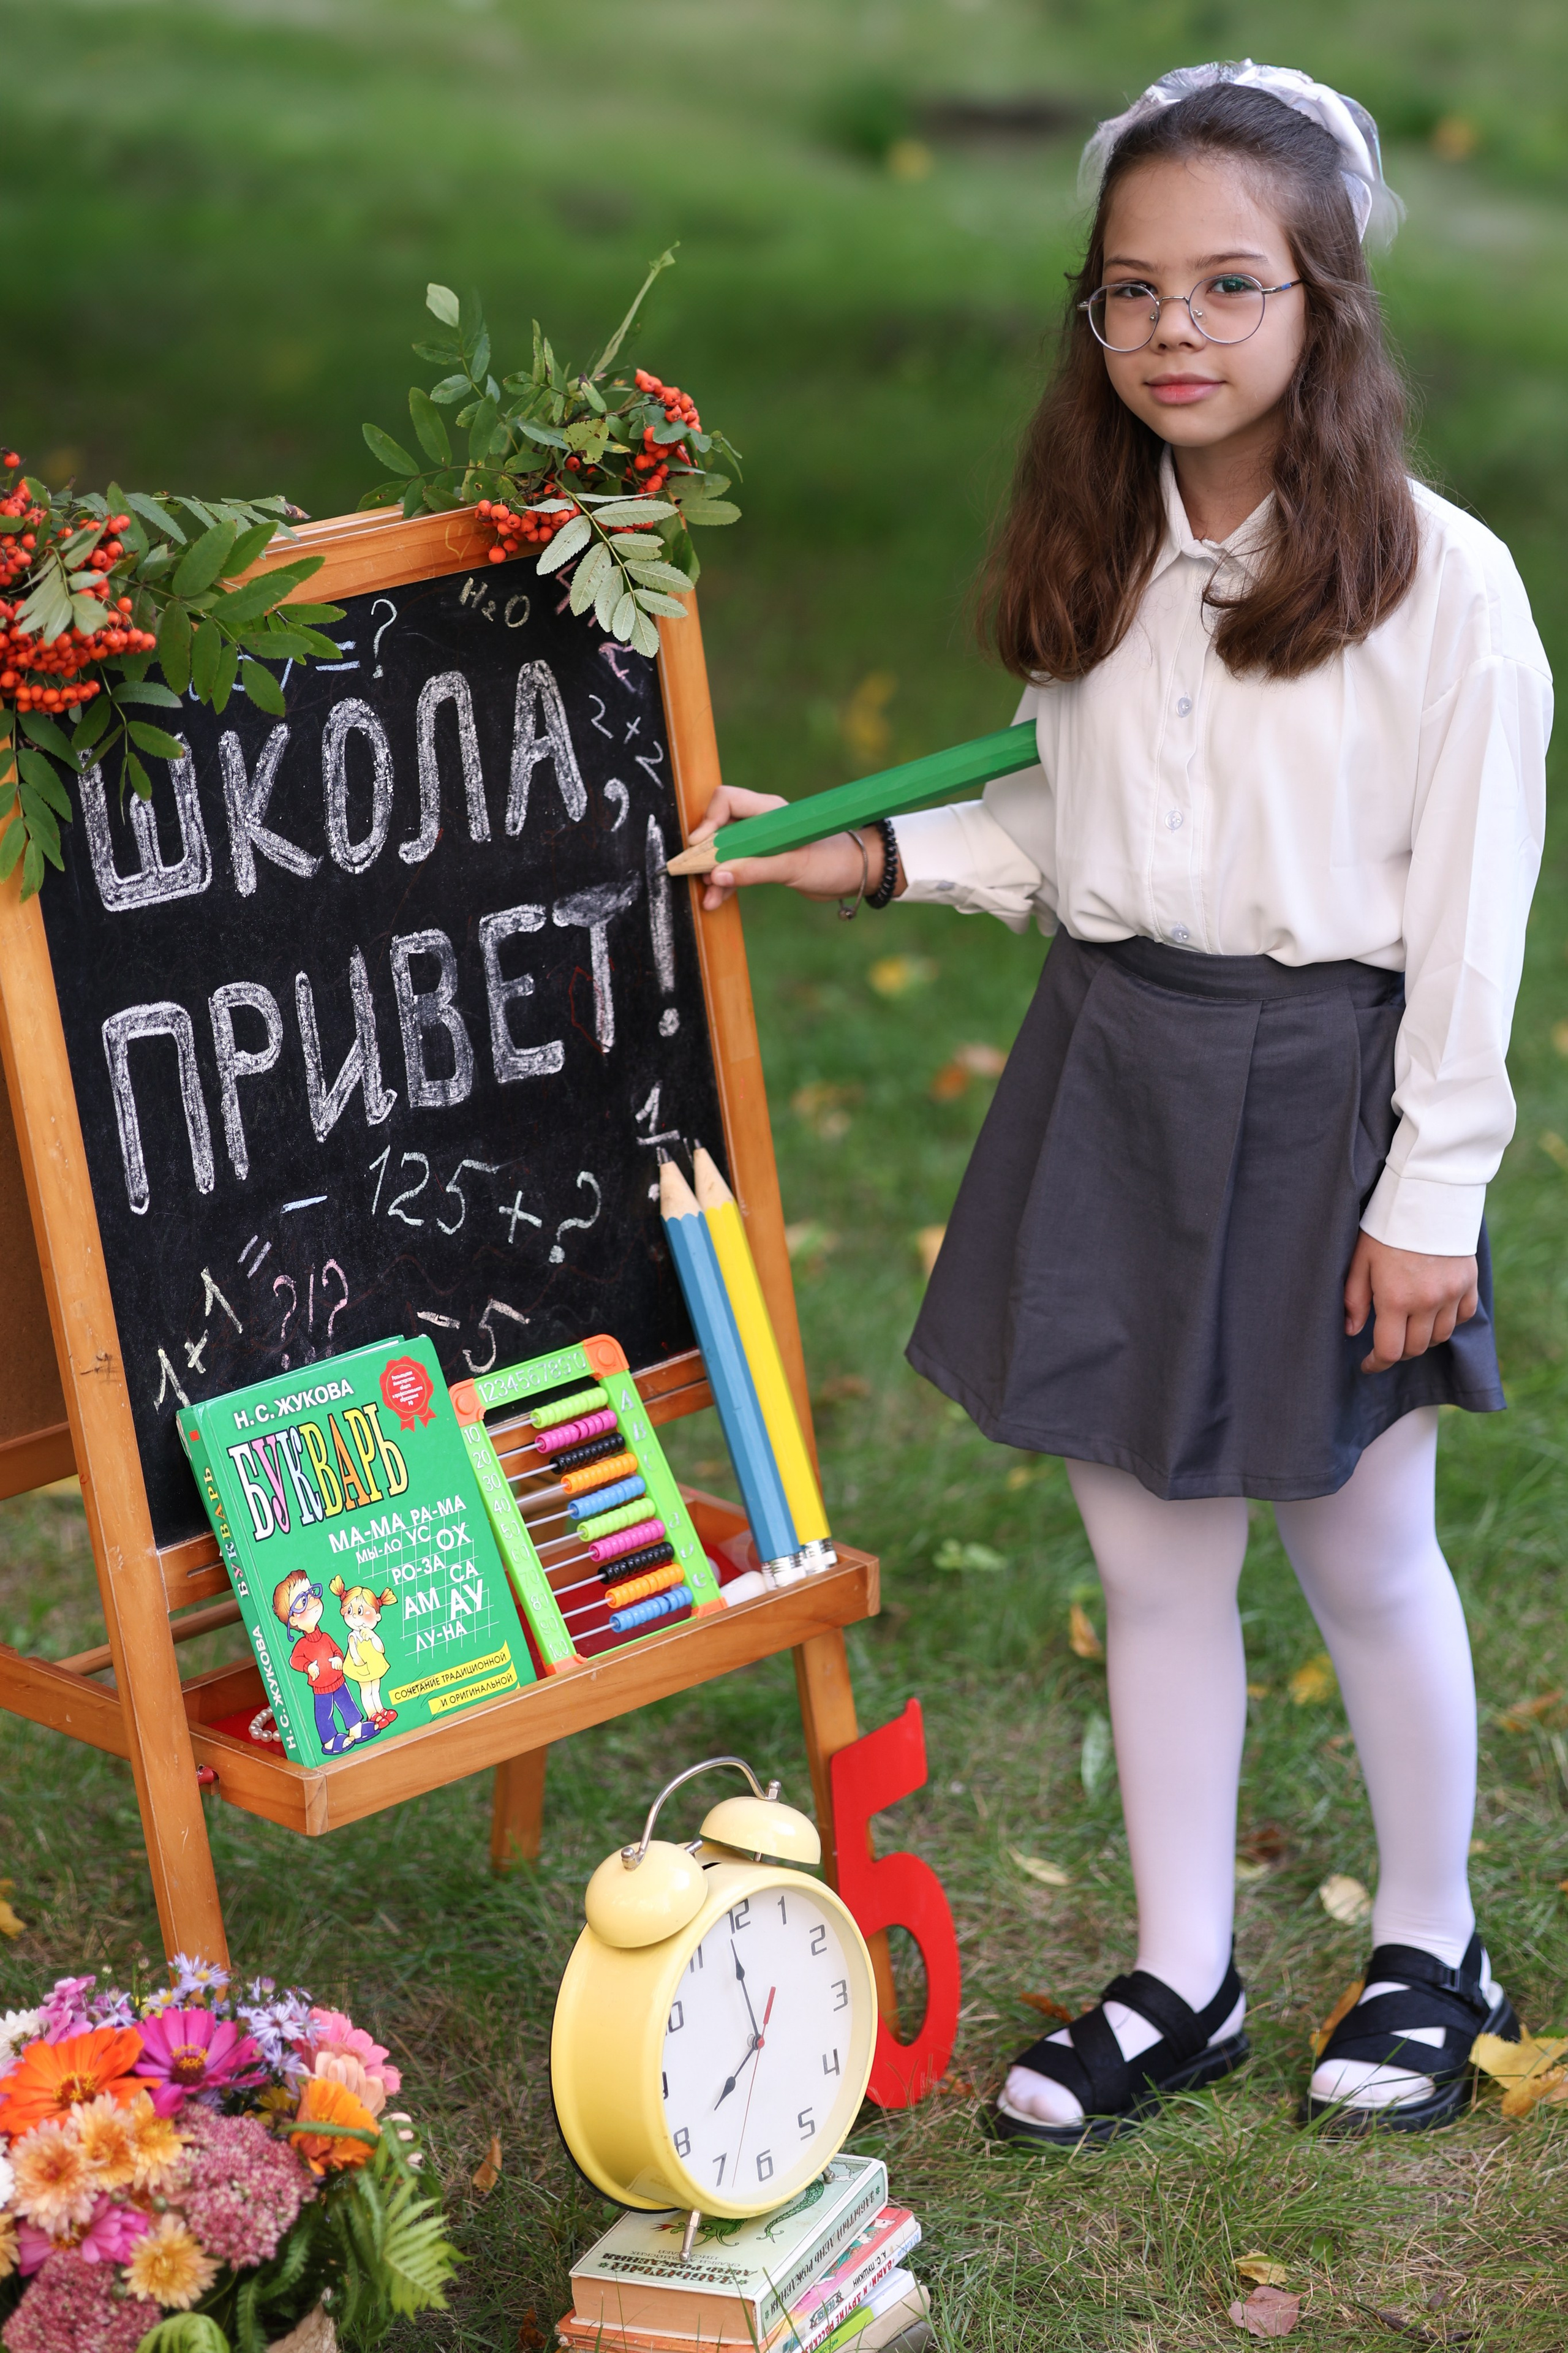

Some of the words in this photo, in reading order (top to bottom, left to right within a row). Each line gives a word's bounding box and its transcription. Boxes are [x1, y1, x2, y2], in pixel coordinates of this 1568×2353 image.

[100, 814, 680, 1216] ПРИВЕТ!
[233, 1410, 254, 1430] Н.
[255, 1404, 275, 1423] С.
[274, 1378, 354, 1418] ЖУКОВА
[464, 1426, 481, 1445] 10
[226, 1402, 409, 1543] БУКВАРЬ
[472, 1449, 492, 1469] 20
[482, 1473, 502, 1492] 30
[493, 1495, 511, 1514] 40
[203, 1467, 250, 1598] БУКВАРЬ
[328, 1512, 407, 1554] МА-МА
[409, 1494, 467, 1527] РА-МА
[500, 1520, 521, 1539] 50
[355, 1538, 402, 1565] МЫ-ЛО
[405, 1525, 432, 1546] УС
[435, 1522, 472, 1551] ОХ
[391, 1554, 447, 1585] РО-ЗА
[449, 1560, 480, 1583] СА
[404, 1587, 441, 1620] АМ
[450, 1578, 483, 1621] АУ
[416, 1620, 468, 1652] ЛУ-НА
[252, 1625, 284, 1708] ЖУКОВА
[394, 1677, 440, 1701] СОЧЕТАНИЕ
[441, 1652, 507, 1683] ТРАДИЦИОННОЙ
[440, 1698, 448, 1707] И
[449, 1673, 514, 1704] ОРИГИНАЛЬНОЙ
[725, 1898, 751, 1934] 12
[777, 1895, 788, 1925] 1
[831, 1697, 962, 2109] 5
[809, 1924, 827, 1956] 2
[831, 1979, 848, 2011] 3
[665, 2000, 684, 2036] 0
[822, 2048, 840, 2076] 4
[797, 2107, 816, 2140] 5
[673, 2127, 691, 2158] 8
[712, 2153, 728, 2187] 7
[756, 2149, 774, 2182] 6
[836, 2191, 875, 2242] ЗАБЫТЫЙ
[815, 2235, 838, 2263] ДЕНЬ
[609, 2261, 734, 2285] ЗАБЫТЫЙ
[852, 2262, 875, 2288] ПУШКИН
